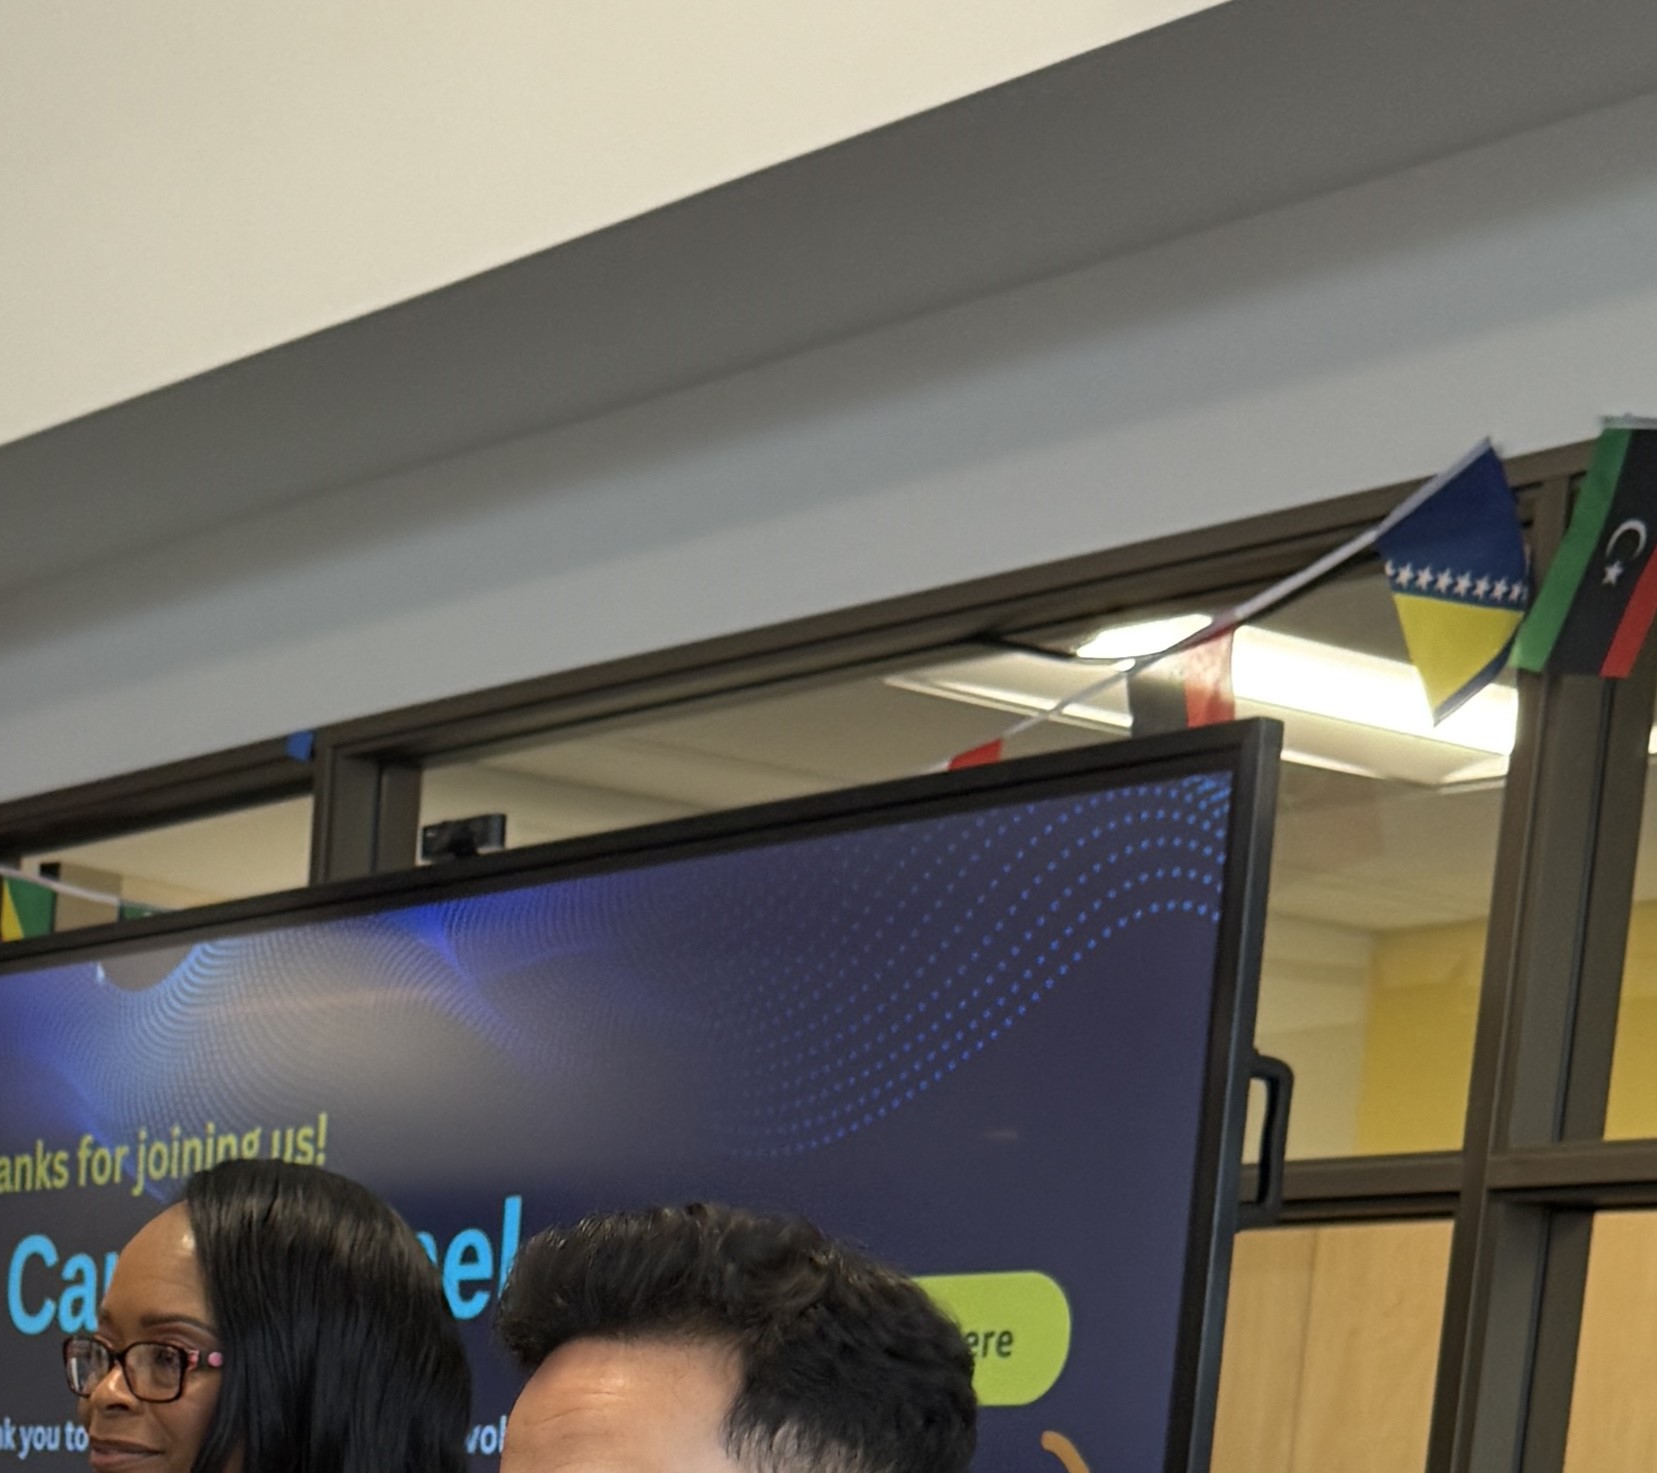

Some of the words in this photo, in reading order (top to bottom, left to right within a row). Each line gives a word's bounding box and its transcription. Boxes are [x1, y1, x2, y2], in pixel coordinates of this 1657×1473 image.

[77, 1134, 129, 1187] for
[131, 1121, 263, 1196] joining
[269, 1112, 328, 1166] us!
[17, 1423, 61, 1460] you
